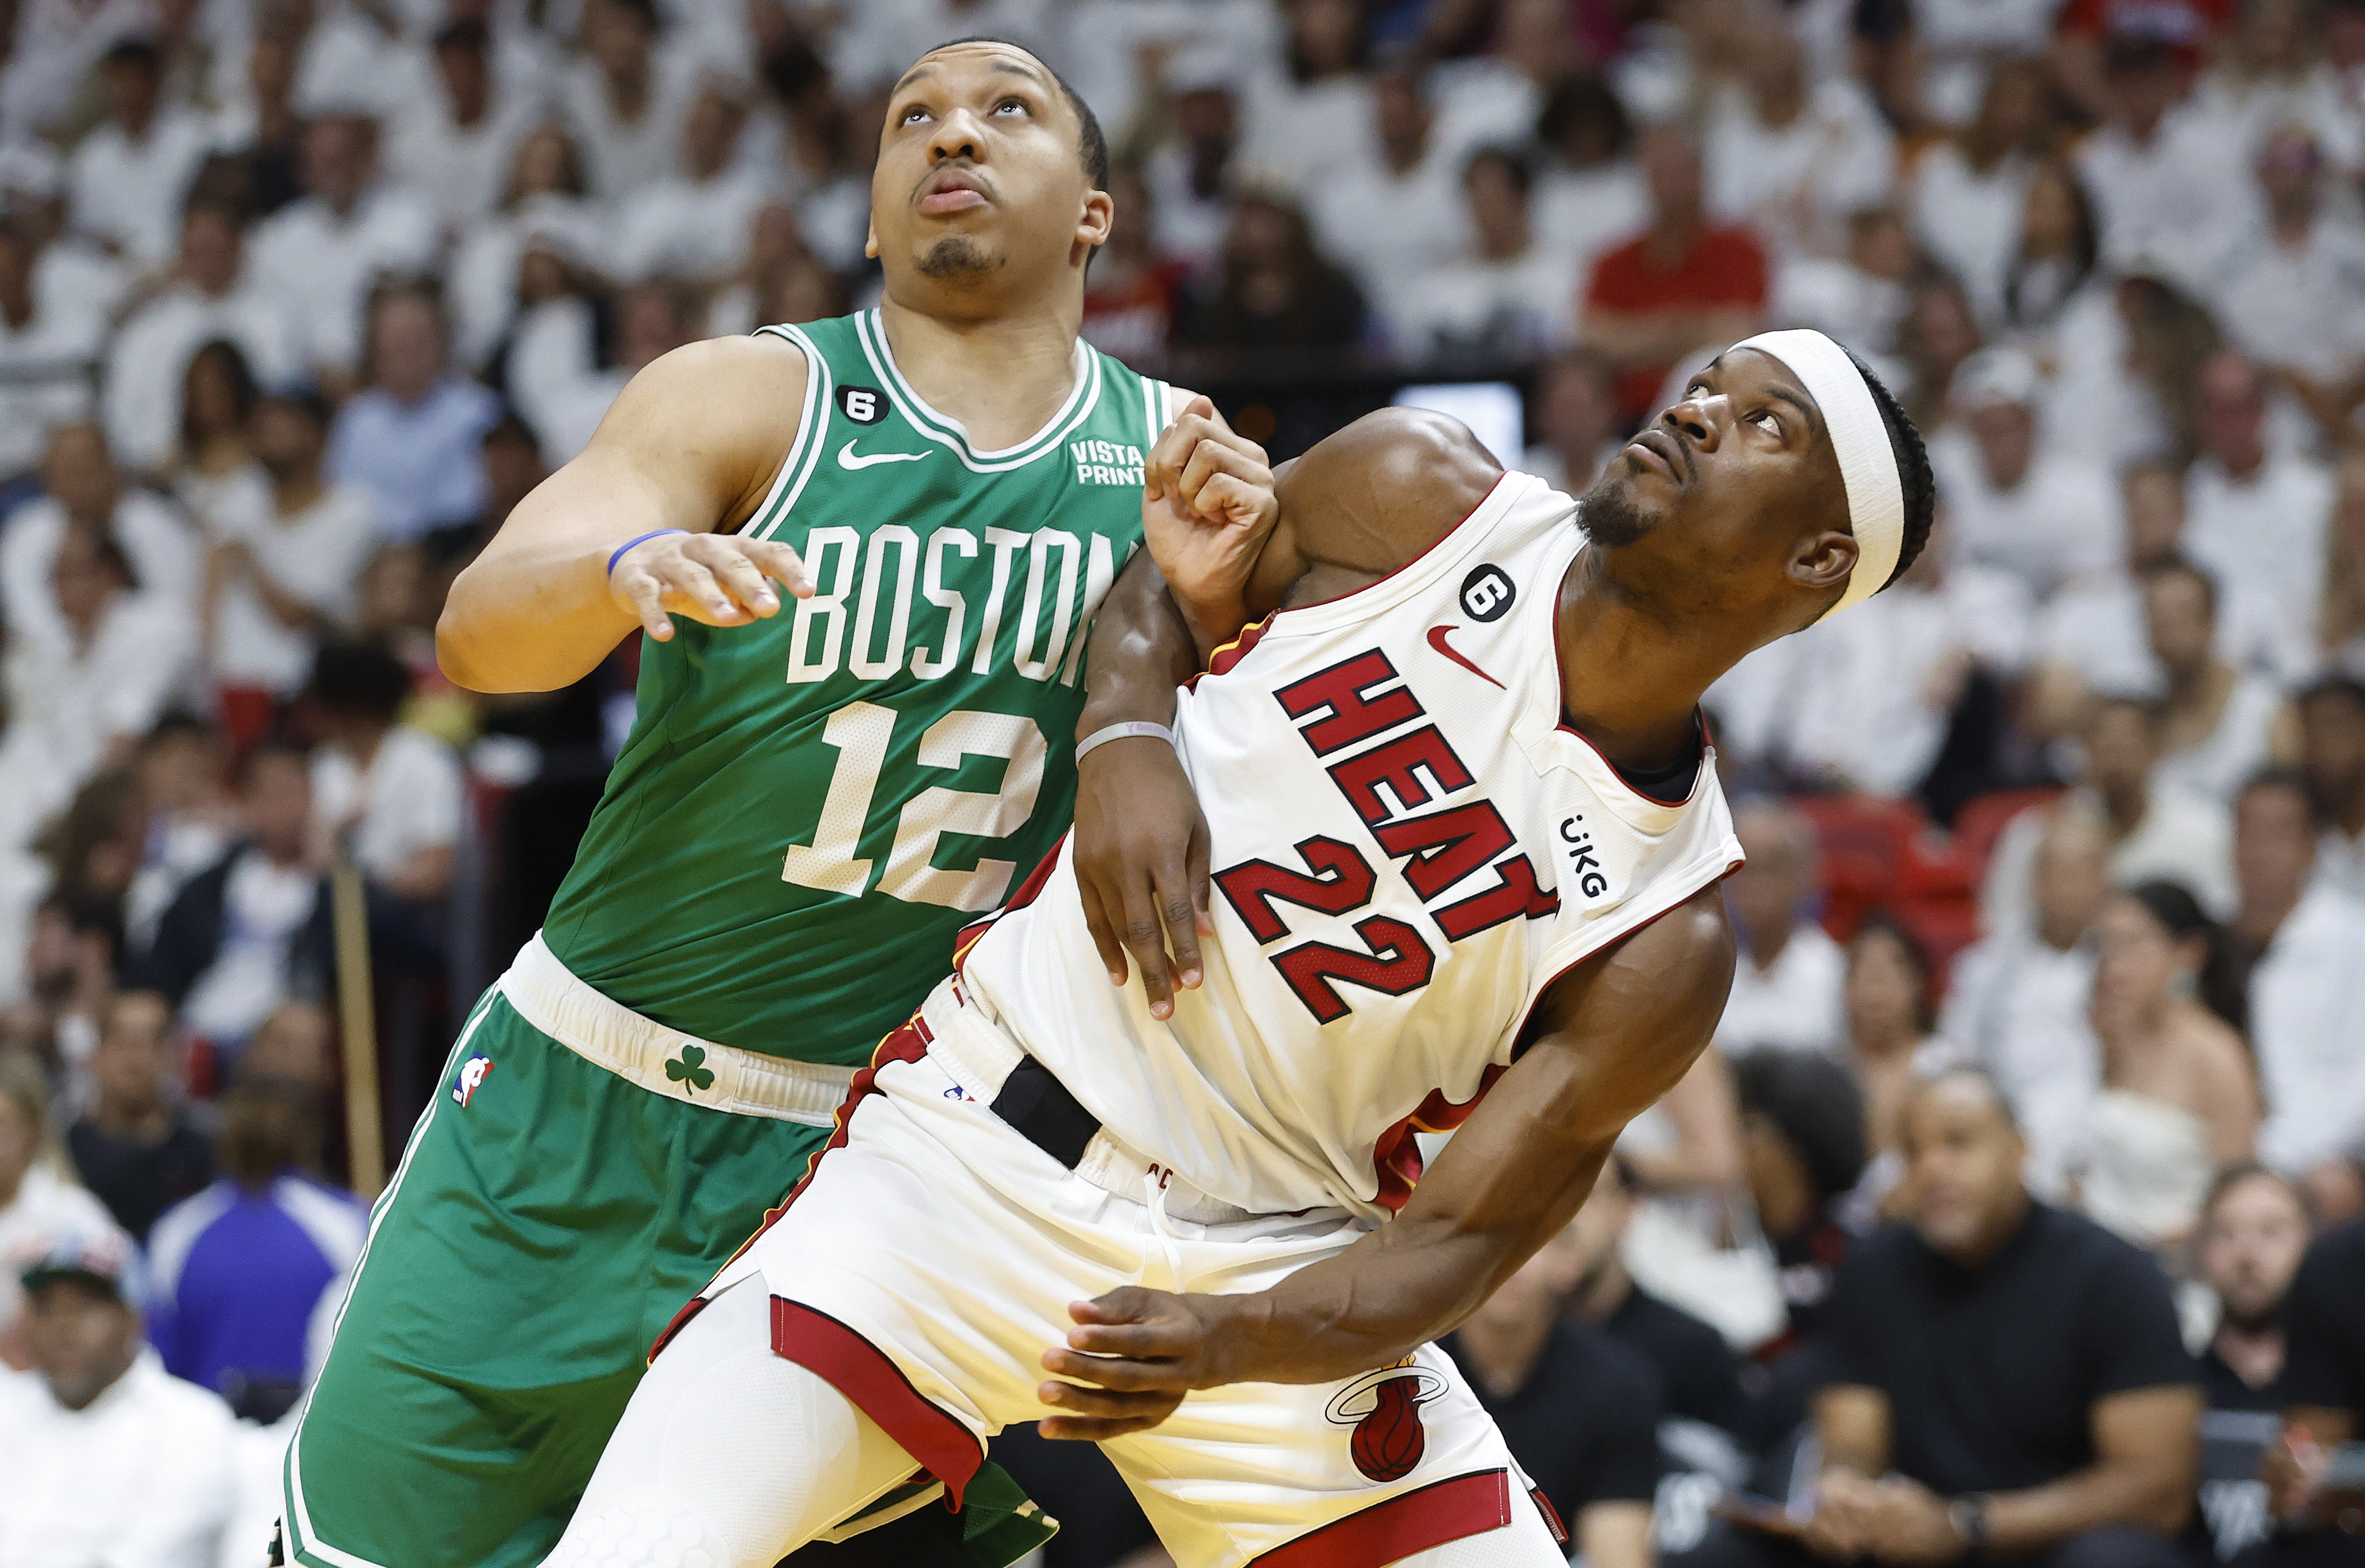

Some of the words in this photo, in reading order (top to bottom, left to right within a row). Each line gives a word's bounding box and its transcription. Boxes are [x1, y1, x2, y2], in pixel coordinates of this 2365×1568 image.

[846, 391, 876, 422] 6
[1070, 439, 1145, 467] VISTA
[1076, 464, 1146, 486] PRINT
[1465, 573, 1508, 616] 6
[781, 700, 1048, 912] 12
[1271, 646, 1562, 943] HEAT
[1210, 834, 1436, 1025] 22
